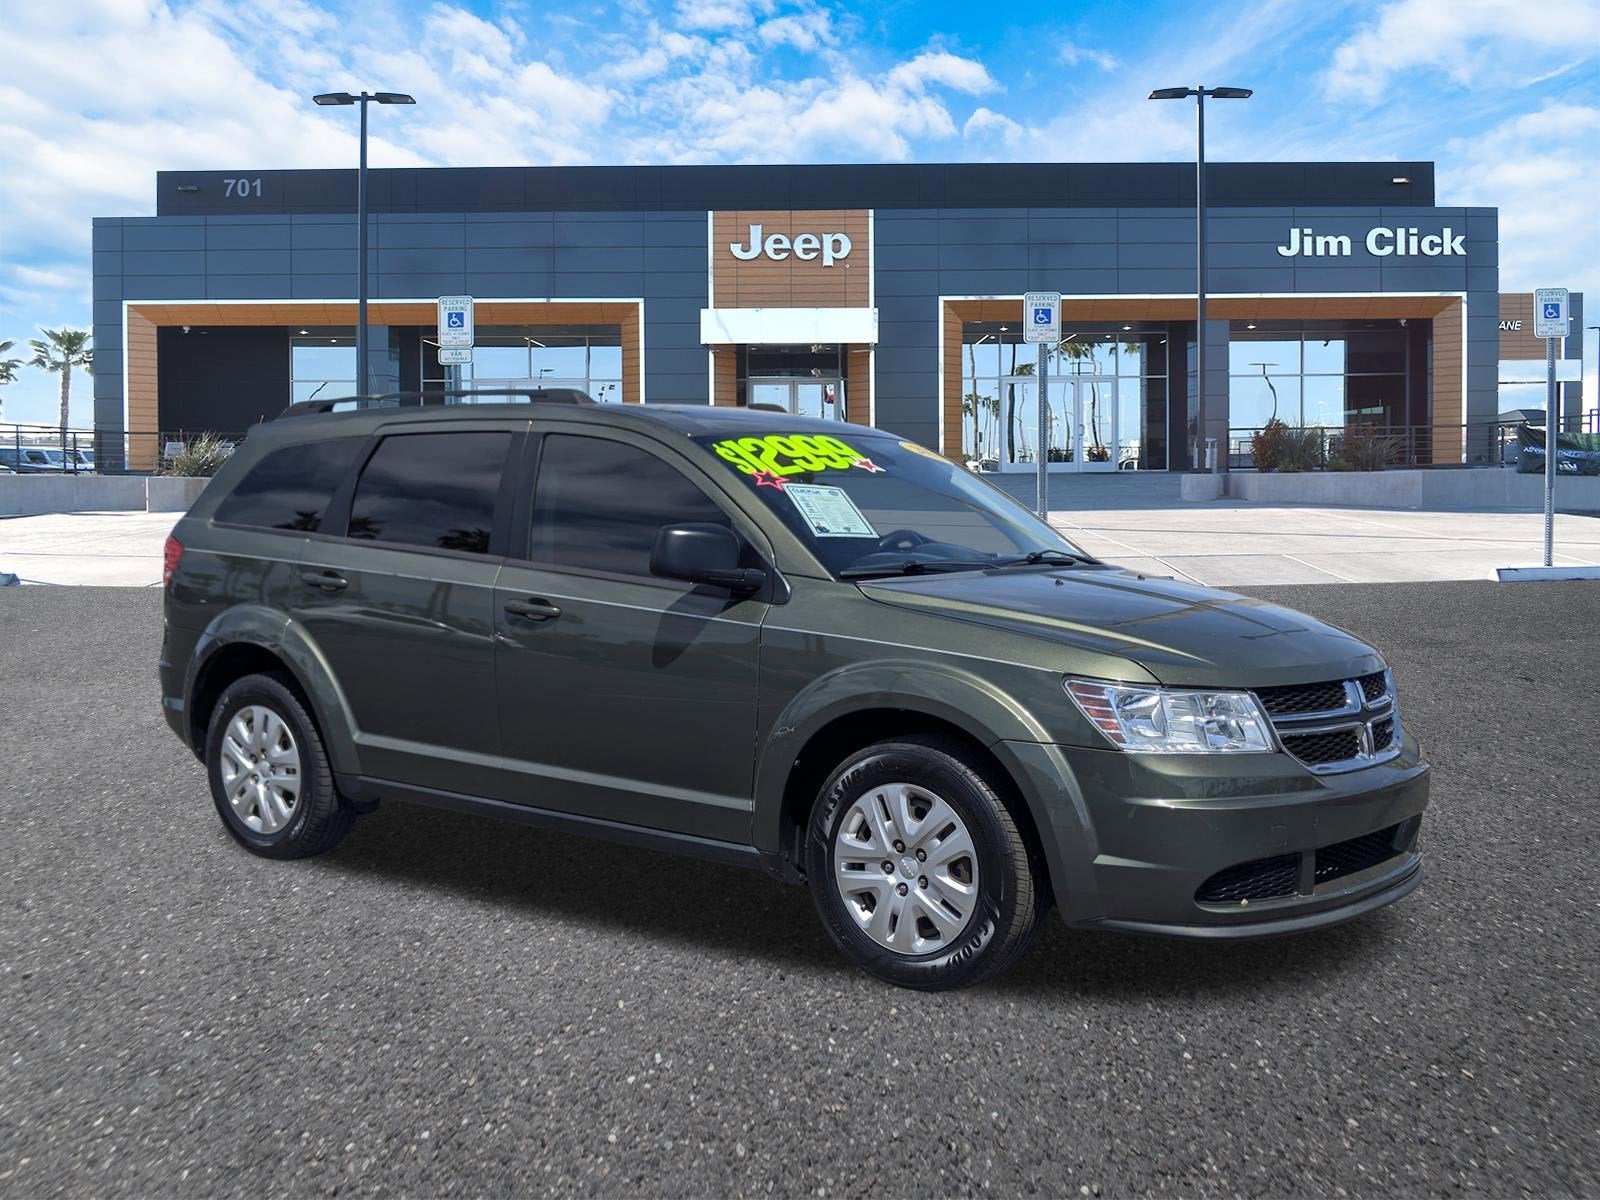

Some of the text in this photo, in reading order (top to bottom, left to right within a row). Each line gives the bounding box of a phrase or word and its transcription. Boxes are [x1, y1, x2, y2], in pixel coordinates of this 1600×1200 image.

[223, 178, 262, 198] 701
[729, 224, 852, 268] Jeep
[1277, 227, 1467, 257] Jim Click
[712, 435, 866, 477] $12999
